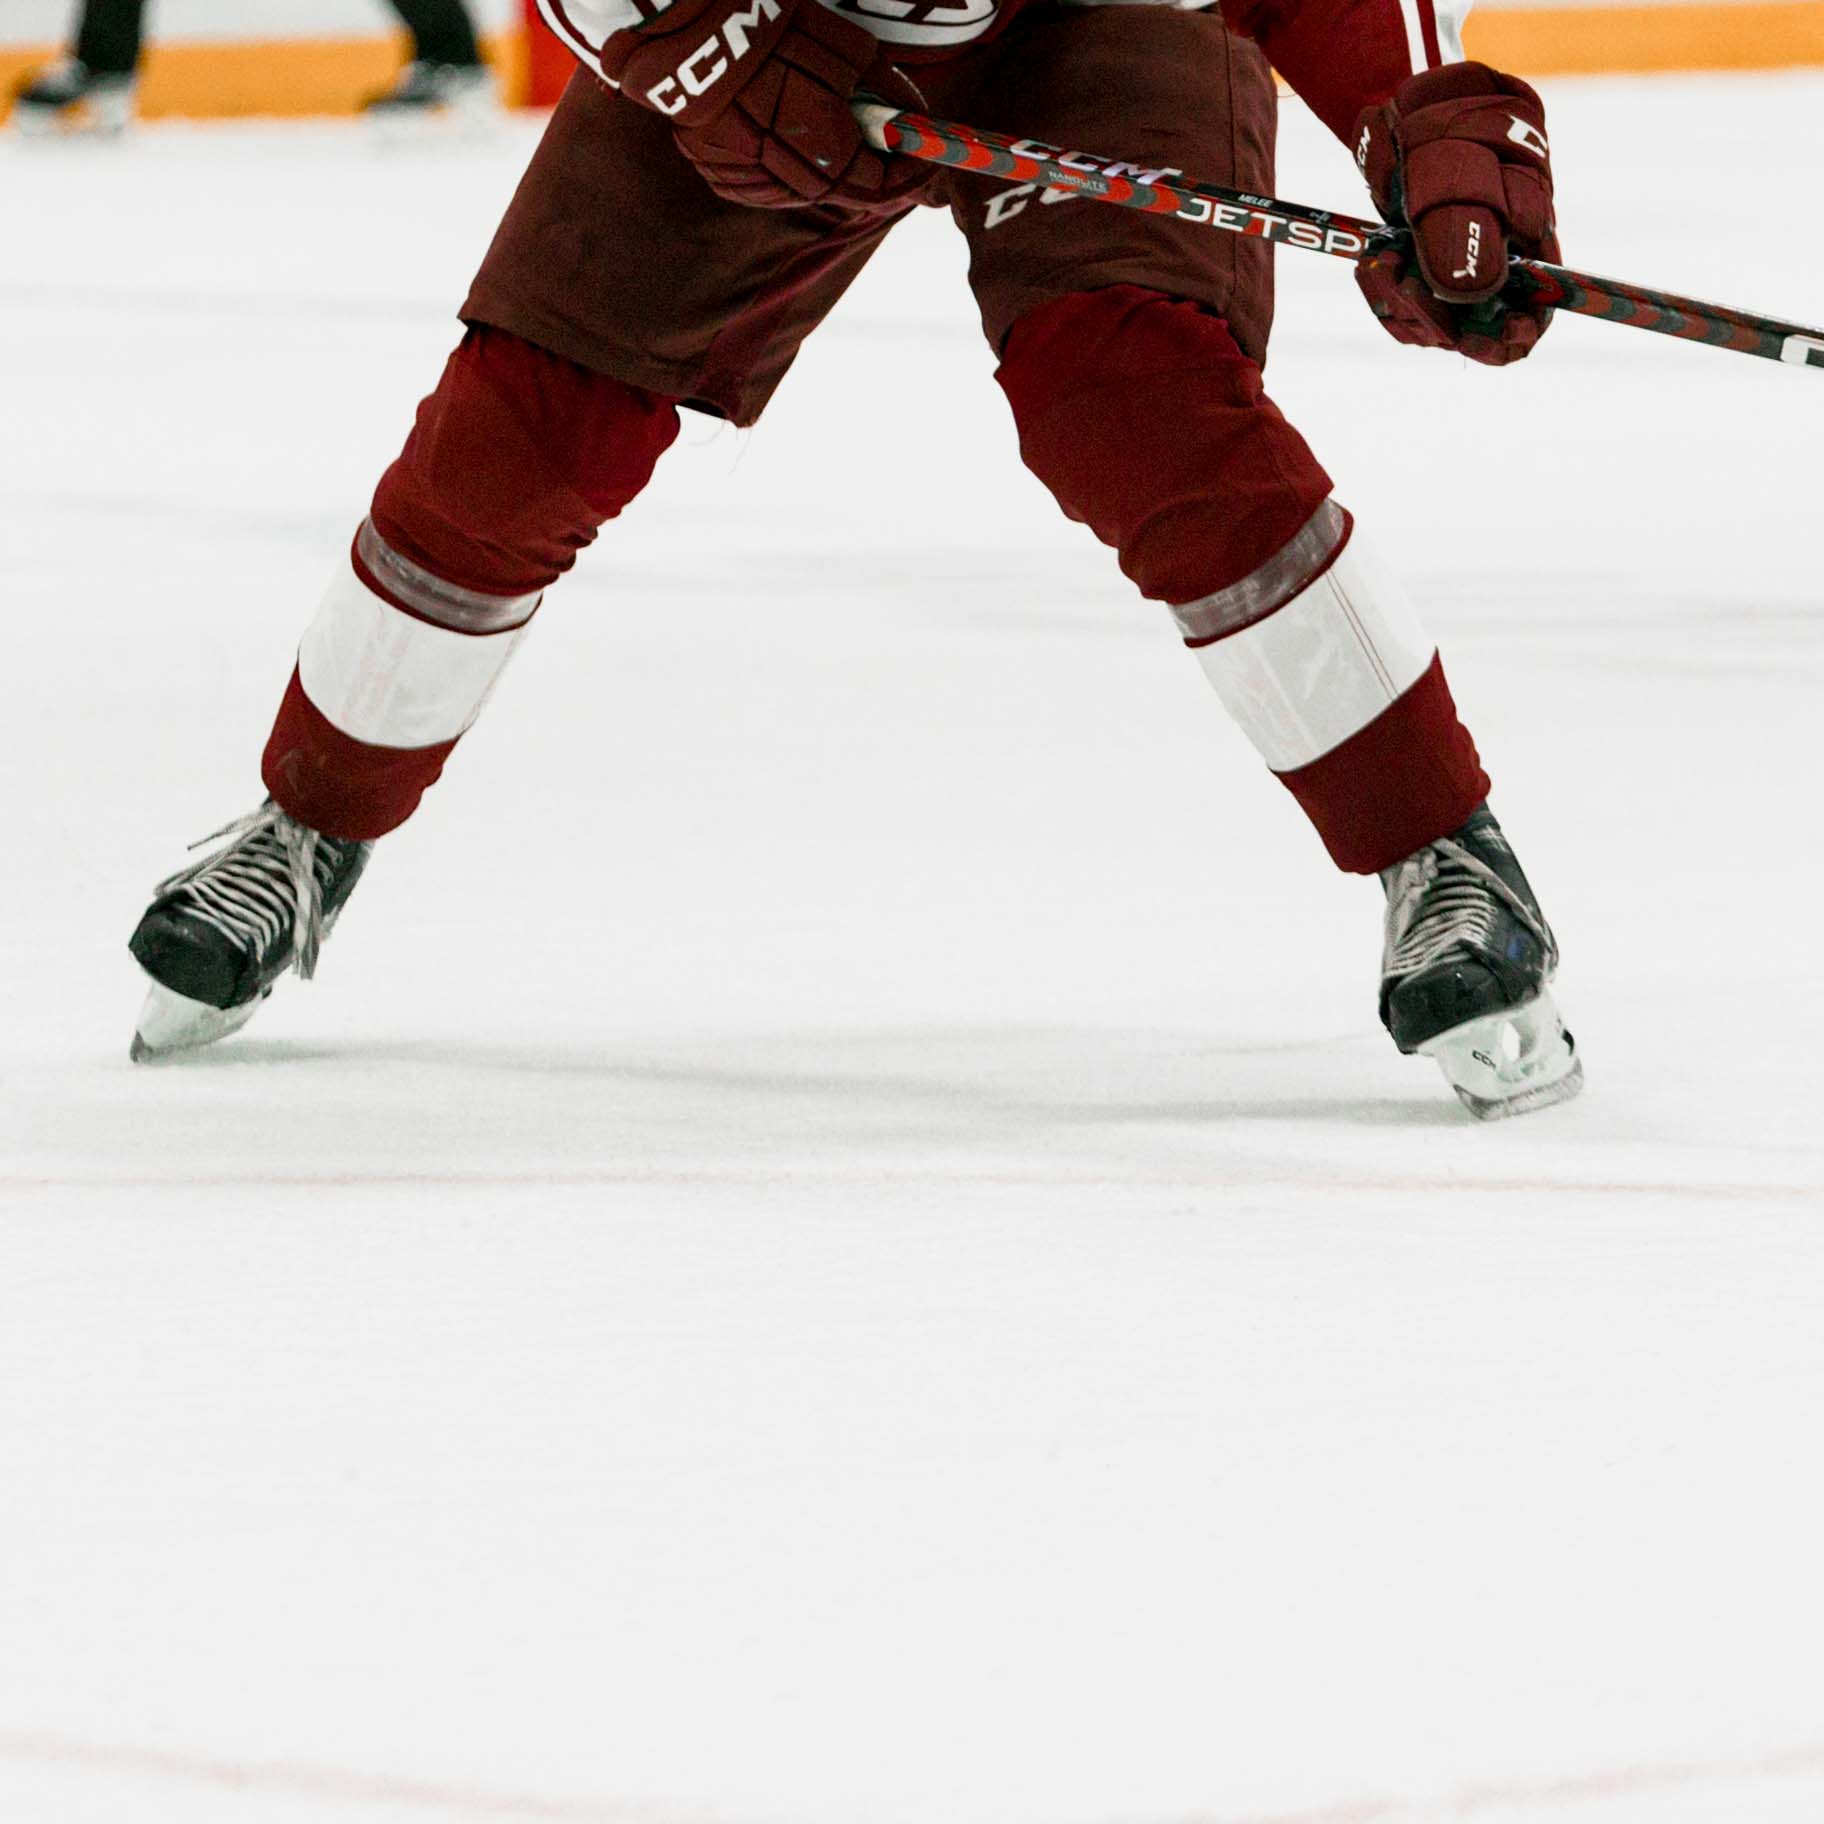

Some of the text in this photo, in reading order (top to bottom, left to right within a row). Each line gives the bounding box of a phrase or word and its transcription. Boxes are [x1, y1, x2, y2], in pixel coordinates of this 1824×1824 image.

[1009, 139, 1183, 186] CCM
[1176, 196, 1369, 254] JETSP
[1238, 193, 1273, 208] MELEE
[1453, 221, 1481, 278] CCM
